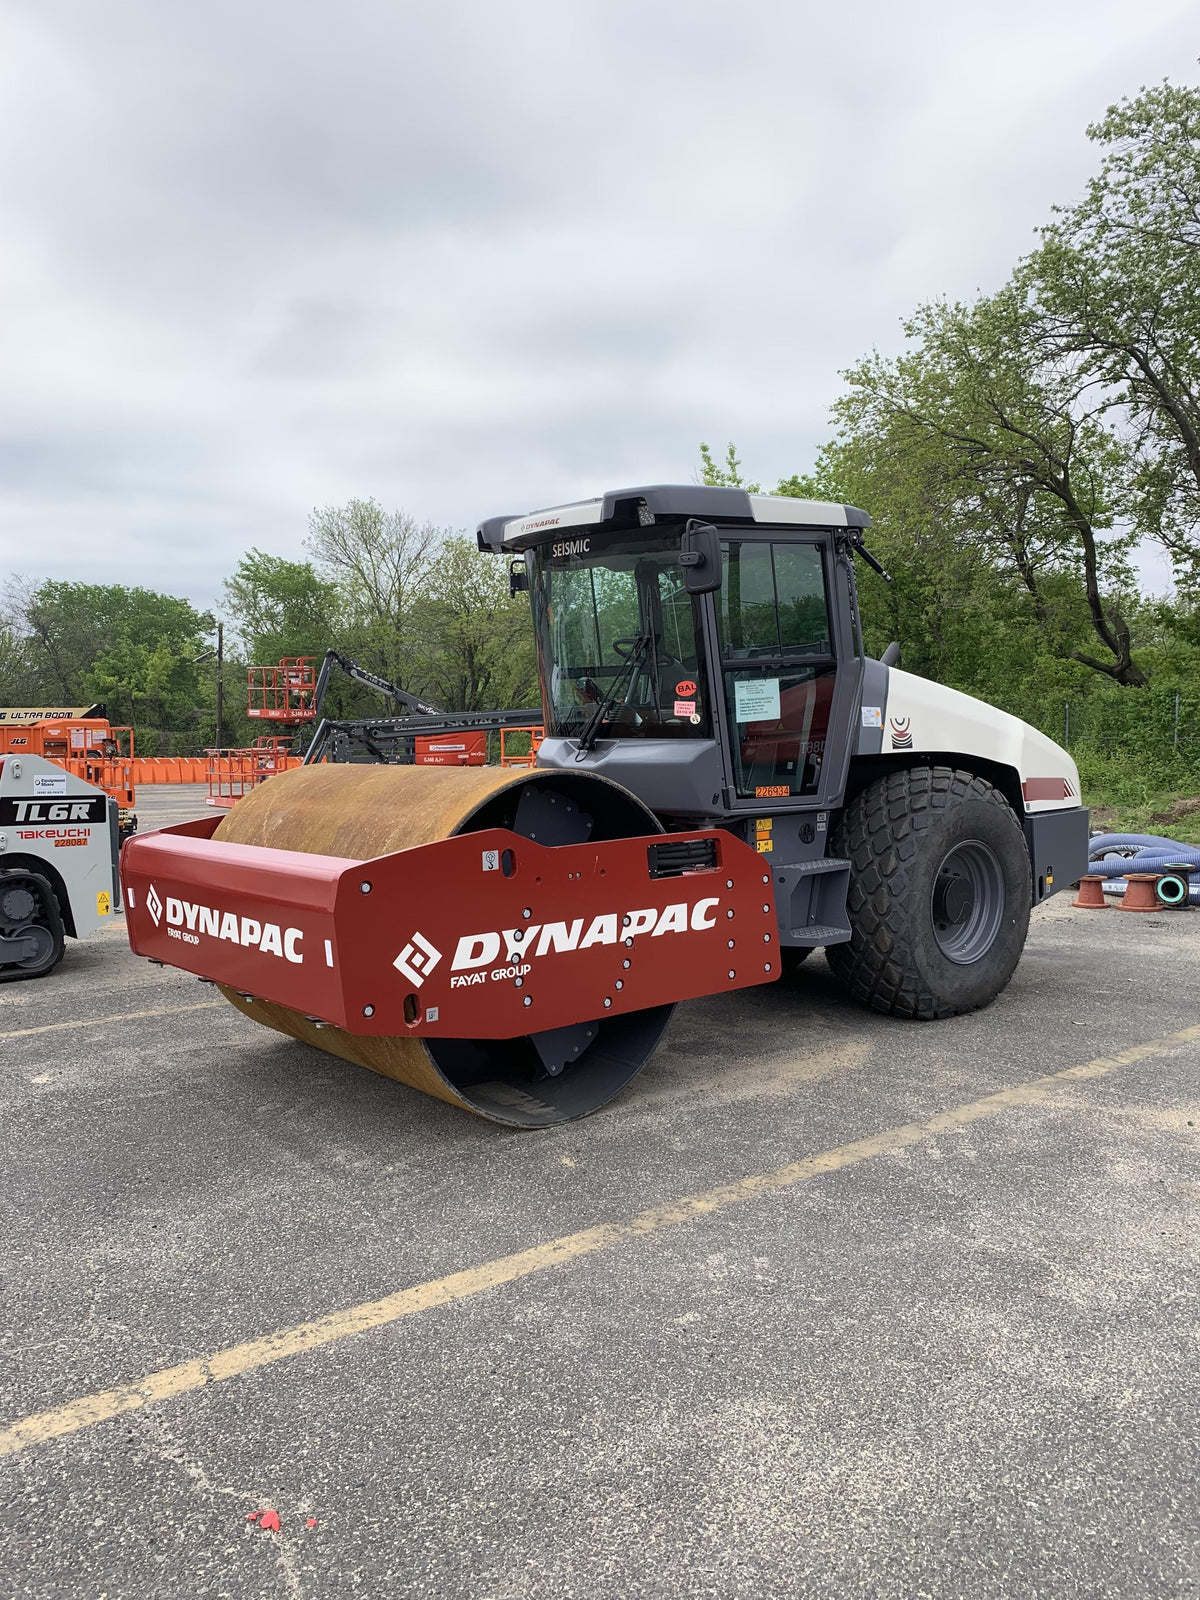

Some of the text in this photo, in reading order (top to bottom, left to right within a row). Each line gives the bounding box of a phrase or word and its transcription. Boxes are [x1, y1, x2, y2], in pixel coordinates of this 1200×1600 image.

[526, 518, 560, 530] DYNAPAC
[552, 538, 590, 558] SEISMIC
[678, 683, 697, 693] BAL
[756, 786, 789, 796] 226934
[12, 798, 96, 821] TL6R
[55, 838, 87, 847] 228087
[166, 897, 303, 964] DYNAPAC
[168, 928, 199, 946] FAYAT GROUP
[450, 897, 720, 971] DYNAPAC
[450, 965, 531, 988] FAYAT GROUP
